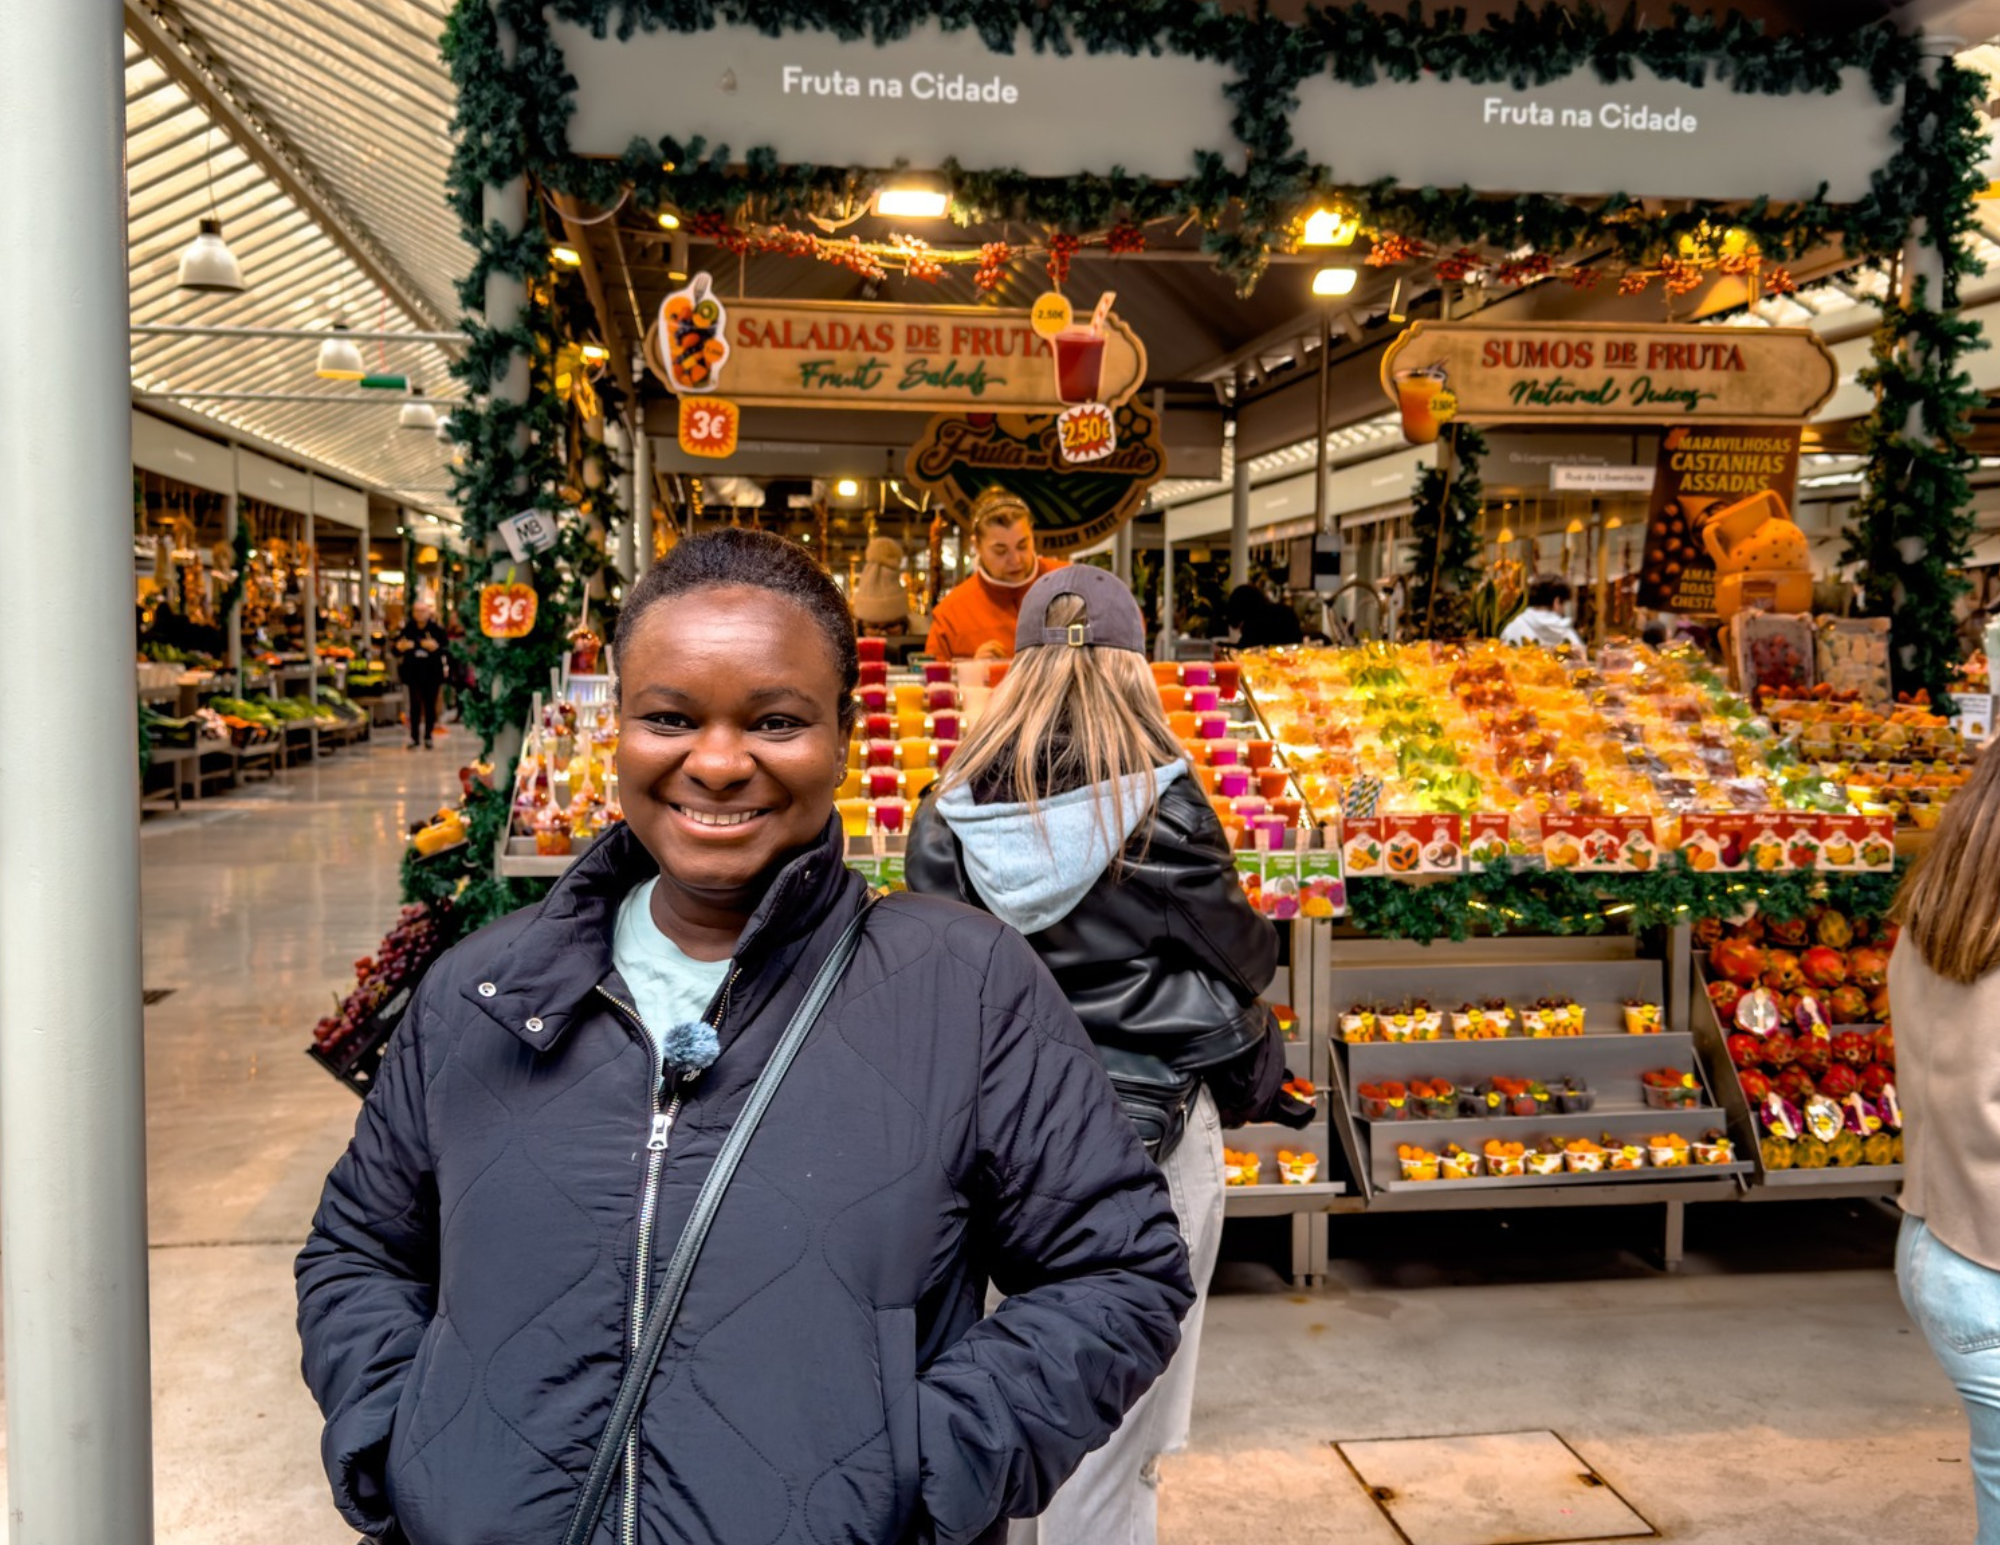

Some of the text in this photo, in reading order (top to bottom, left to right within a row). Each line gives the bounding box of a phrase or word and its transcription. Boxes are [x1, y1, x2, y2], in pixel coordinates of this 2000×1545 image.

[782, 65, 1019, 104] Fruta na Cidade
[1483, 97, 1698, 133] Fruta na Cidade
[736, 317, 895, 354] SALADAS
[905, 325, 941, 349] DE
[1481, 339, 1746, 372] SUMOS DE FRUTA
[799, 356, 1008, 397] Fruit Salads
[1508, 375, 1718, 412] Natural Juices
[690, 410, 726, 440] 3€
[1678, 436, 1792, 454] MARAVILHOSAS
[1670, 453, 1785, 474] CASTANHAS
[1679, 473, 1770, 493] ASSADAS
[490, 596, 527, 624] 3€
